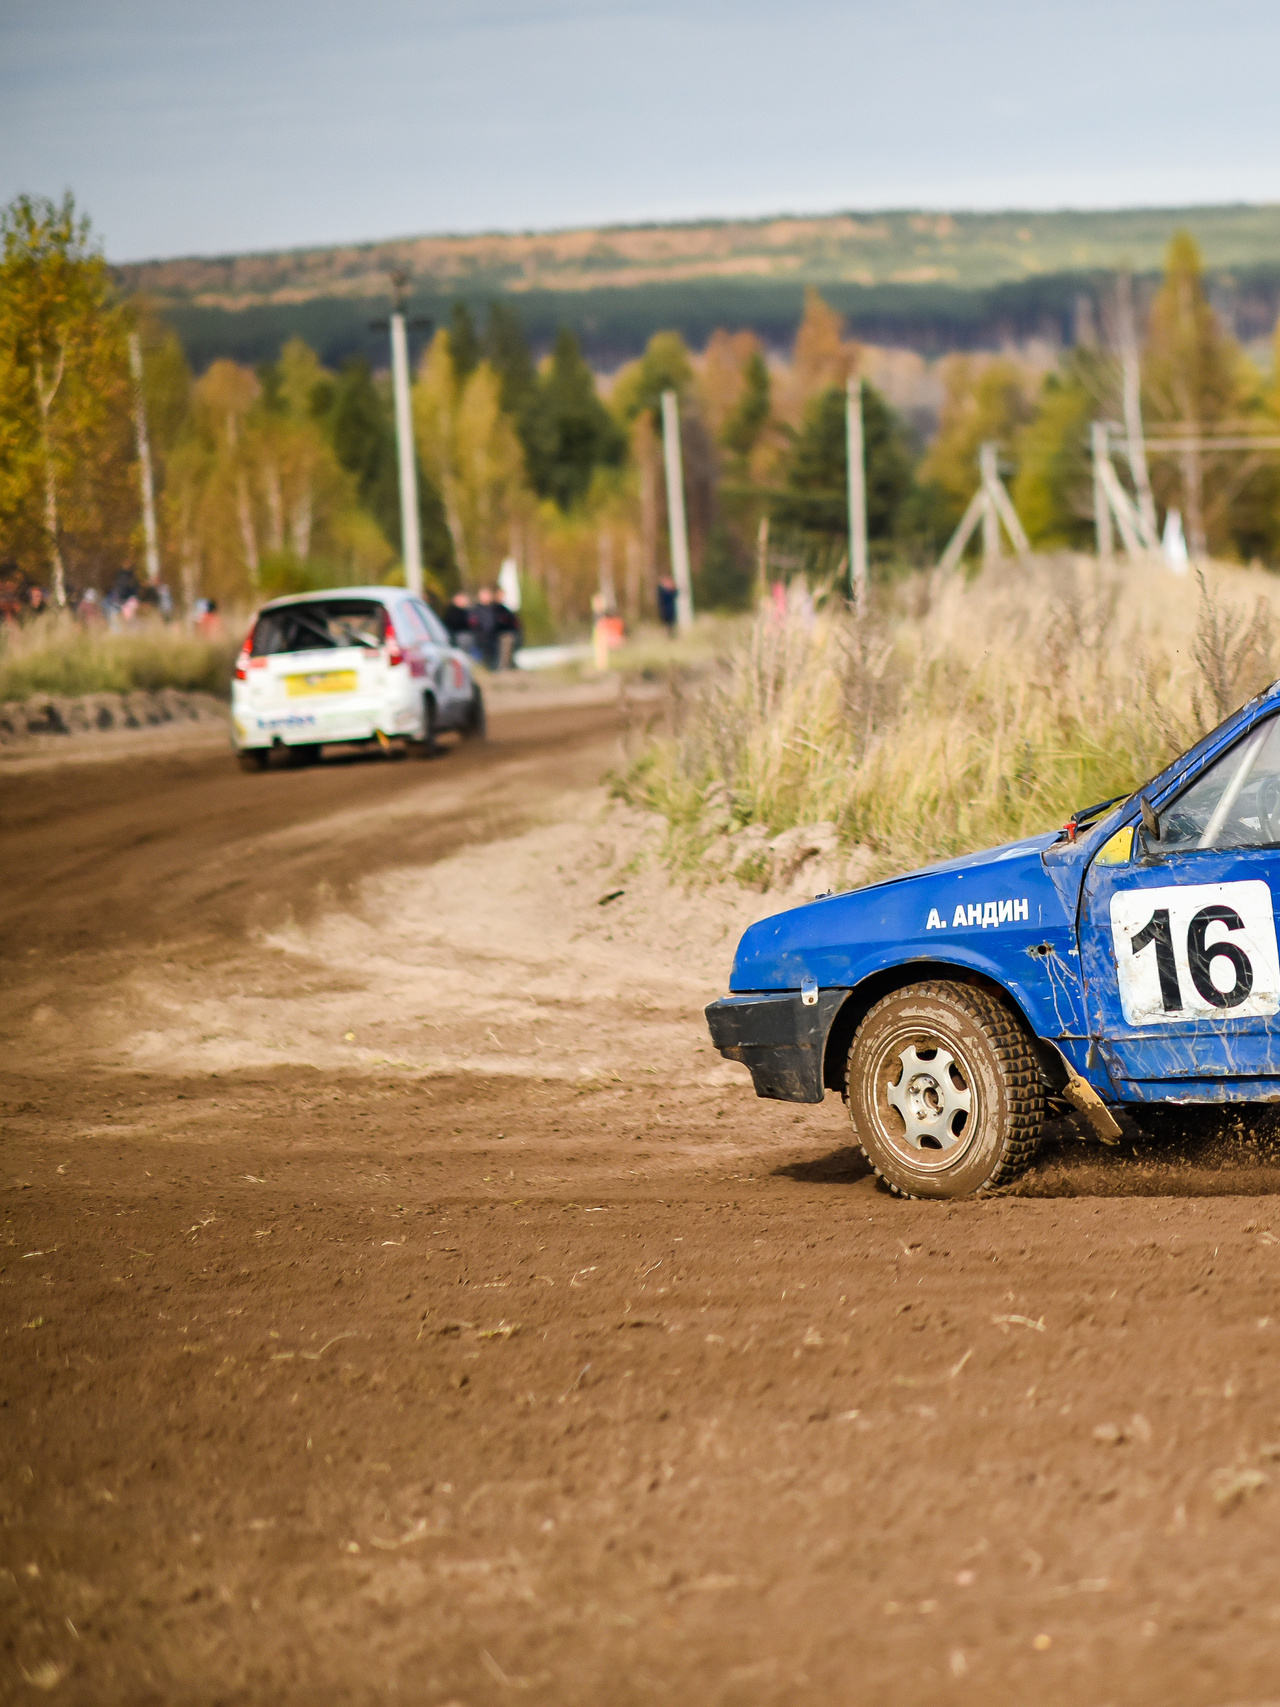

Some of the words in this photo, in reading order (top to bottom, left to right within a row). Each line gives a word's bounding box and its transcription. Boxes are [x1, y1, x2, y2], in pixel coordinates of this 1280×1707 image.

[926, 907, 947, 930] А.
[952, 898, 1029, 928] АНДИН
[1131, 905, 1254, 1013] 16
